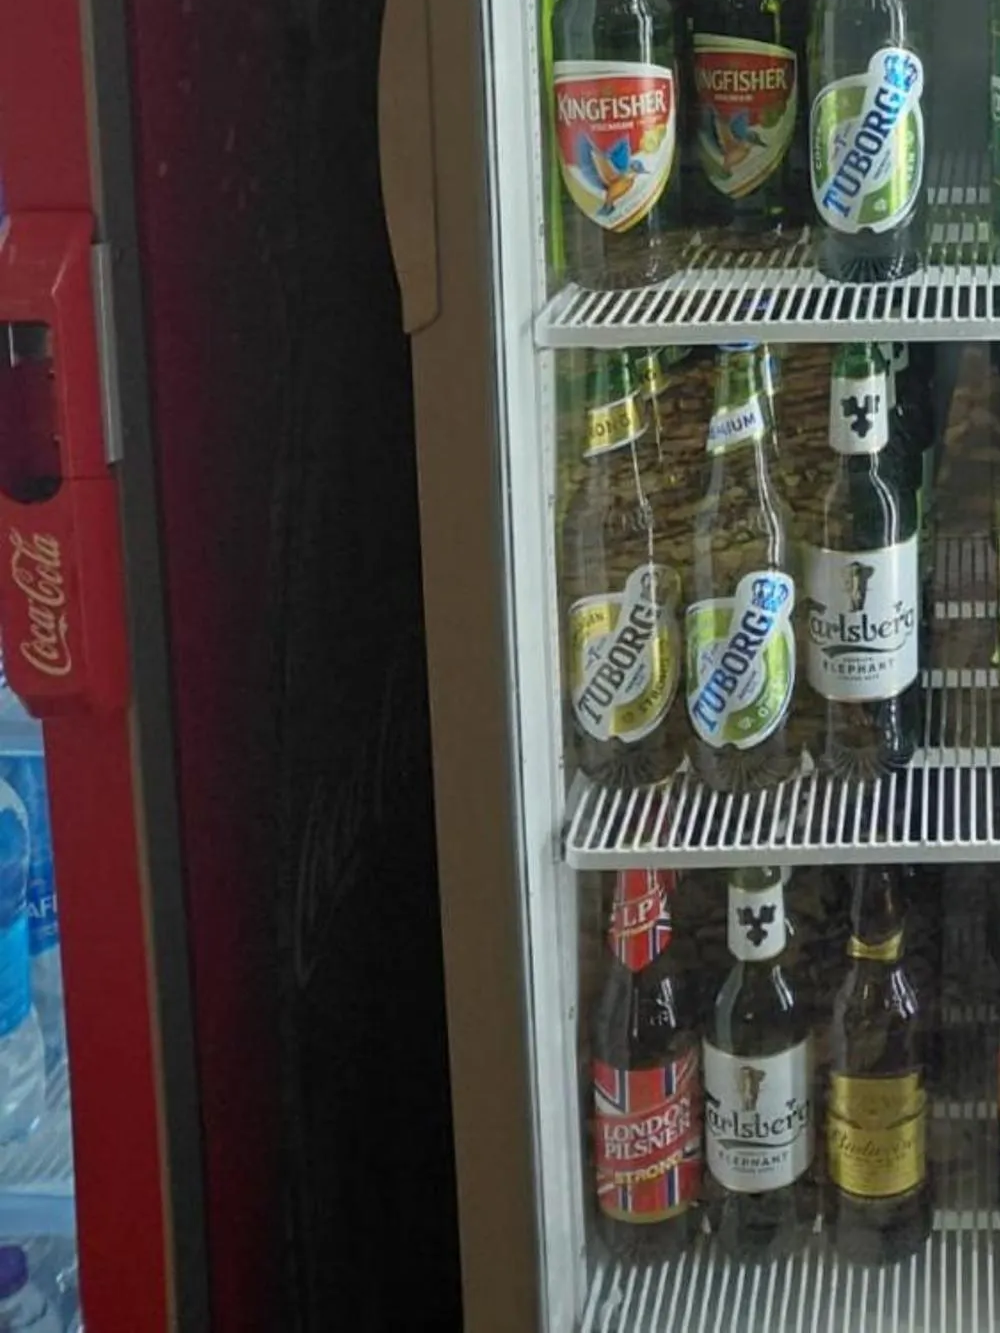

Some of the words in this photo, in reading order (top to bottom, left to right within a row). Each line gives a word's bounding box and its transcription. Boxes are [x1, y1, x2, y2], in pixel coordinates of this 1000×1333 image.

[700, 68, 788, 91] NGFISHER
[557, 89, 668, 125] KINGFISHER
[823, 87, 905, 218] TUBORG
[578, 605, 661, 725] TUBORG
[693, 610, 774, 734] TUBORG
[603, 1097, 691, 1142] LONDON
[604, 1111, 691, 1160] PILSNER
